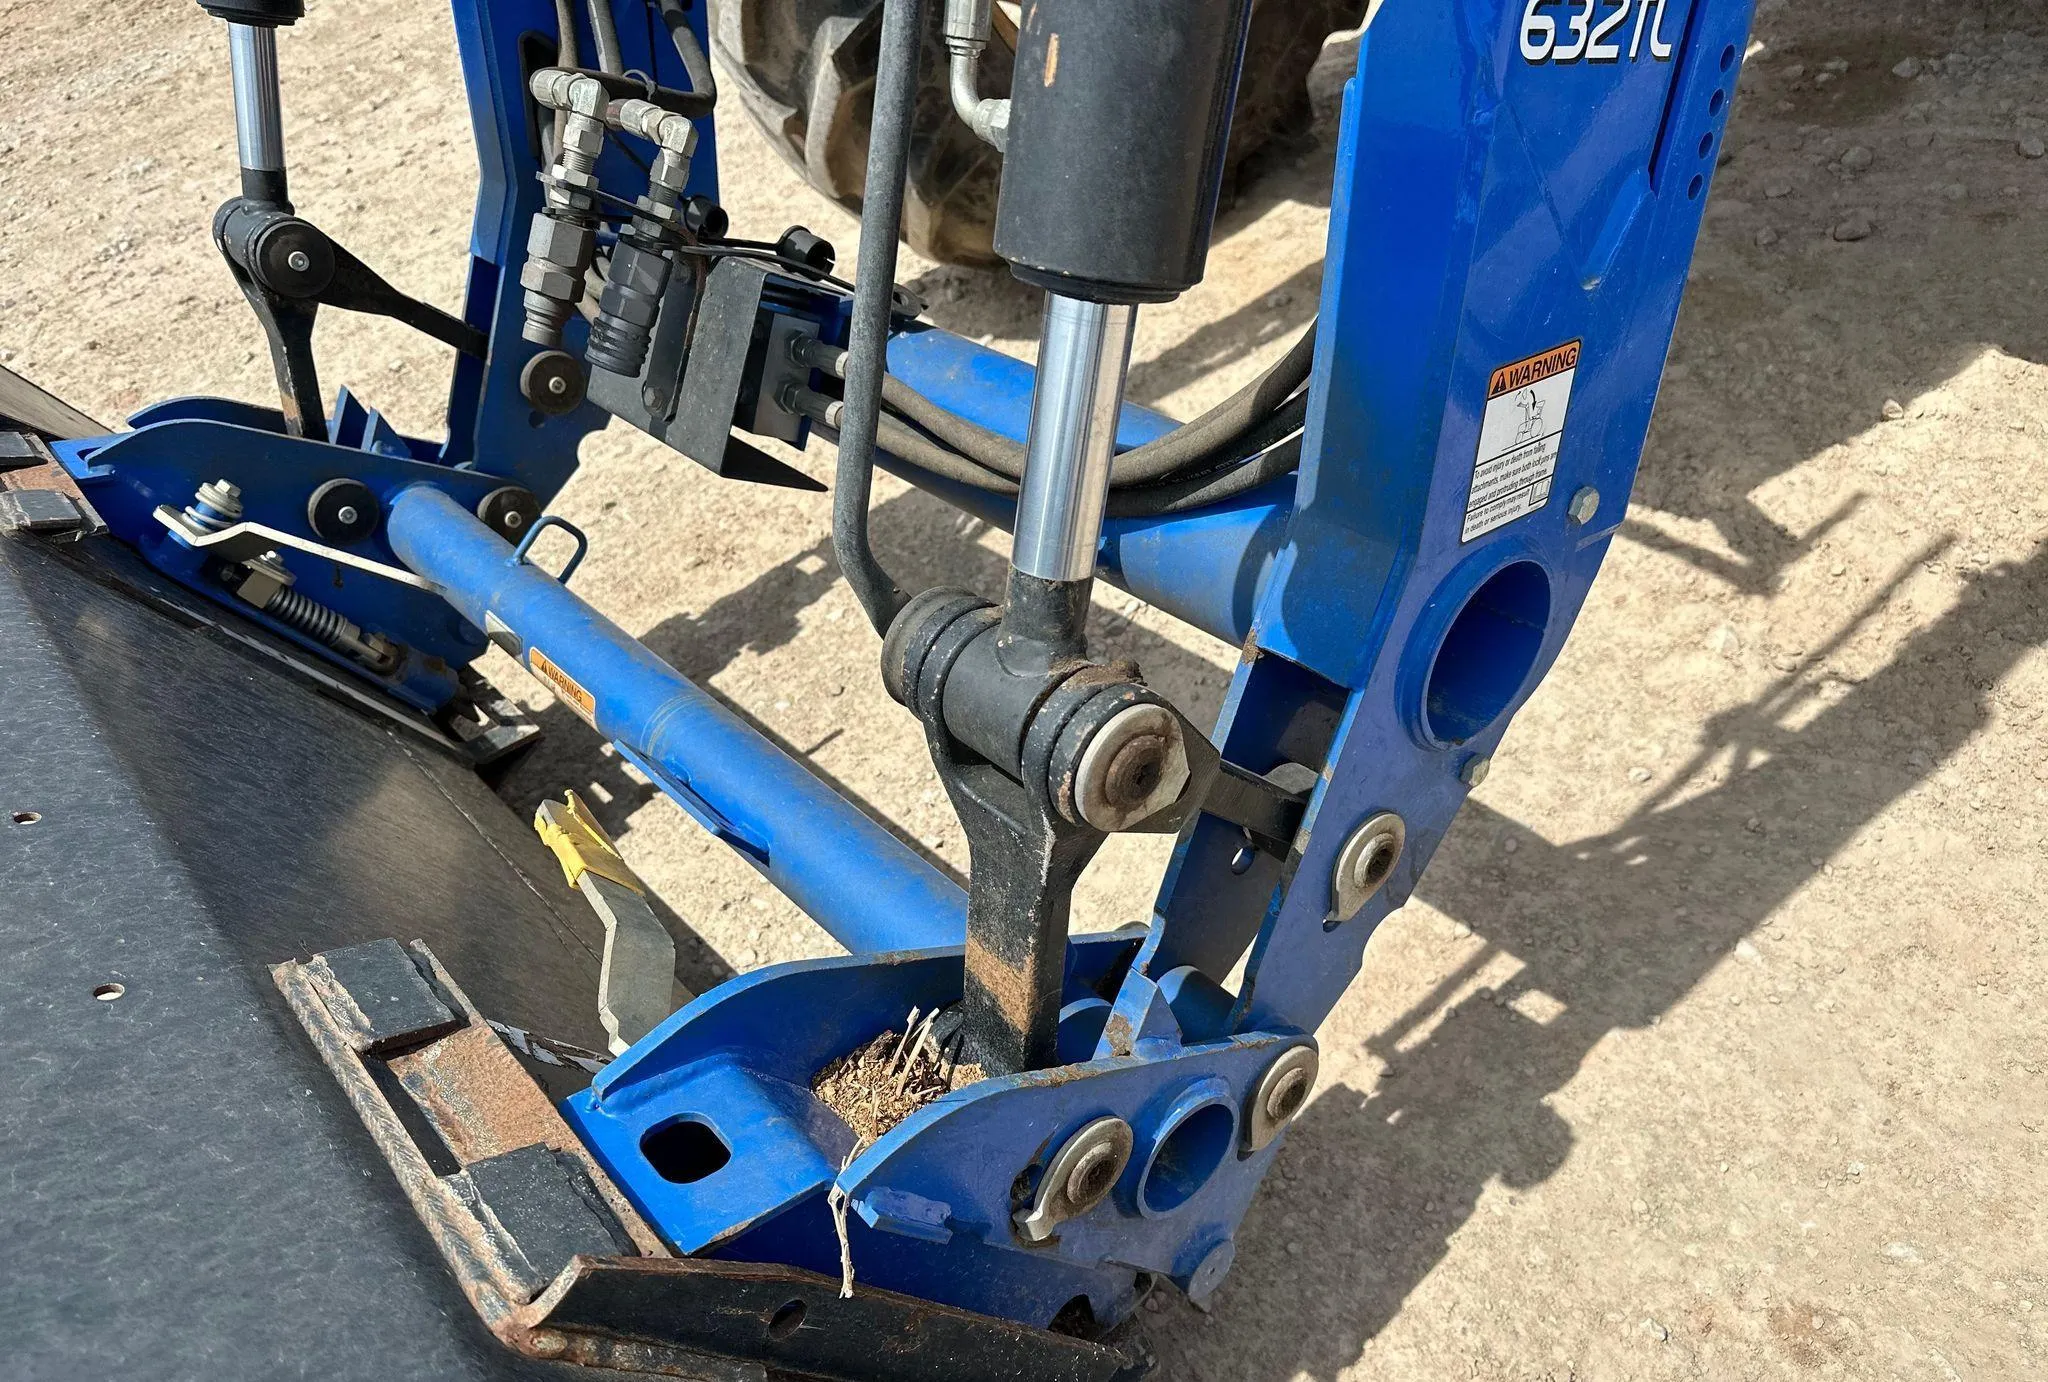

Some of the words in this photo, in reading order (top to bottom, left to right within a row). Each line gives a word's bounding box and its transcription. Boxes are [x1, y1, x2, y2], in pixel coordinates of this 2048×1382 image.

[1509, 347, 1577, 389] WARNING
[1510, 453, 1522, 464] death
[1522, 449, 1533, 458] from
[1499, 470, 1511, 481] make
[1511, 467, 1521, 476] sure
[1521, 462, 1531, 472] both
[1467, 510, 1483, 523] Failure
[1489, 500, 1506, 513] comply
[1506, 495, 1517, 504] may
[1518, 488, 1530, 500] result
[1488, 490, 1497, 500] and
[1470, 519, 1484, 532] death
[1490, 511, 1507, 523] serious
[548, 665, 582, 702] WARNING
